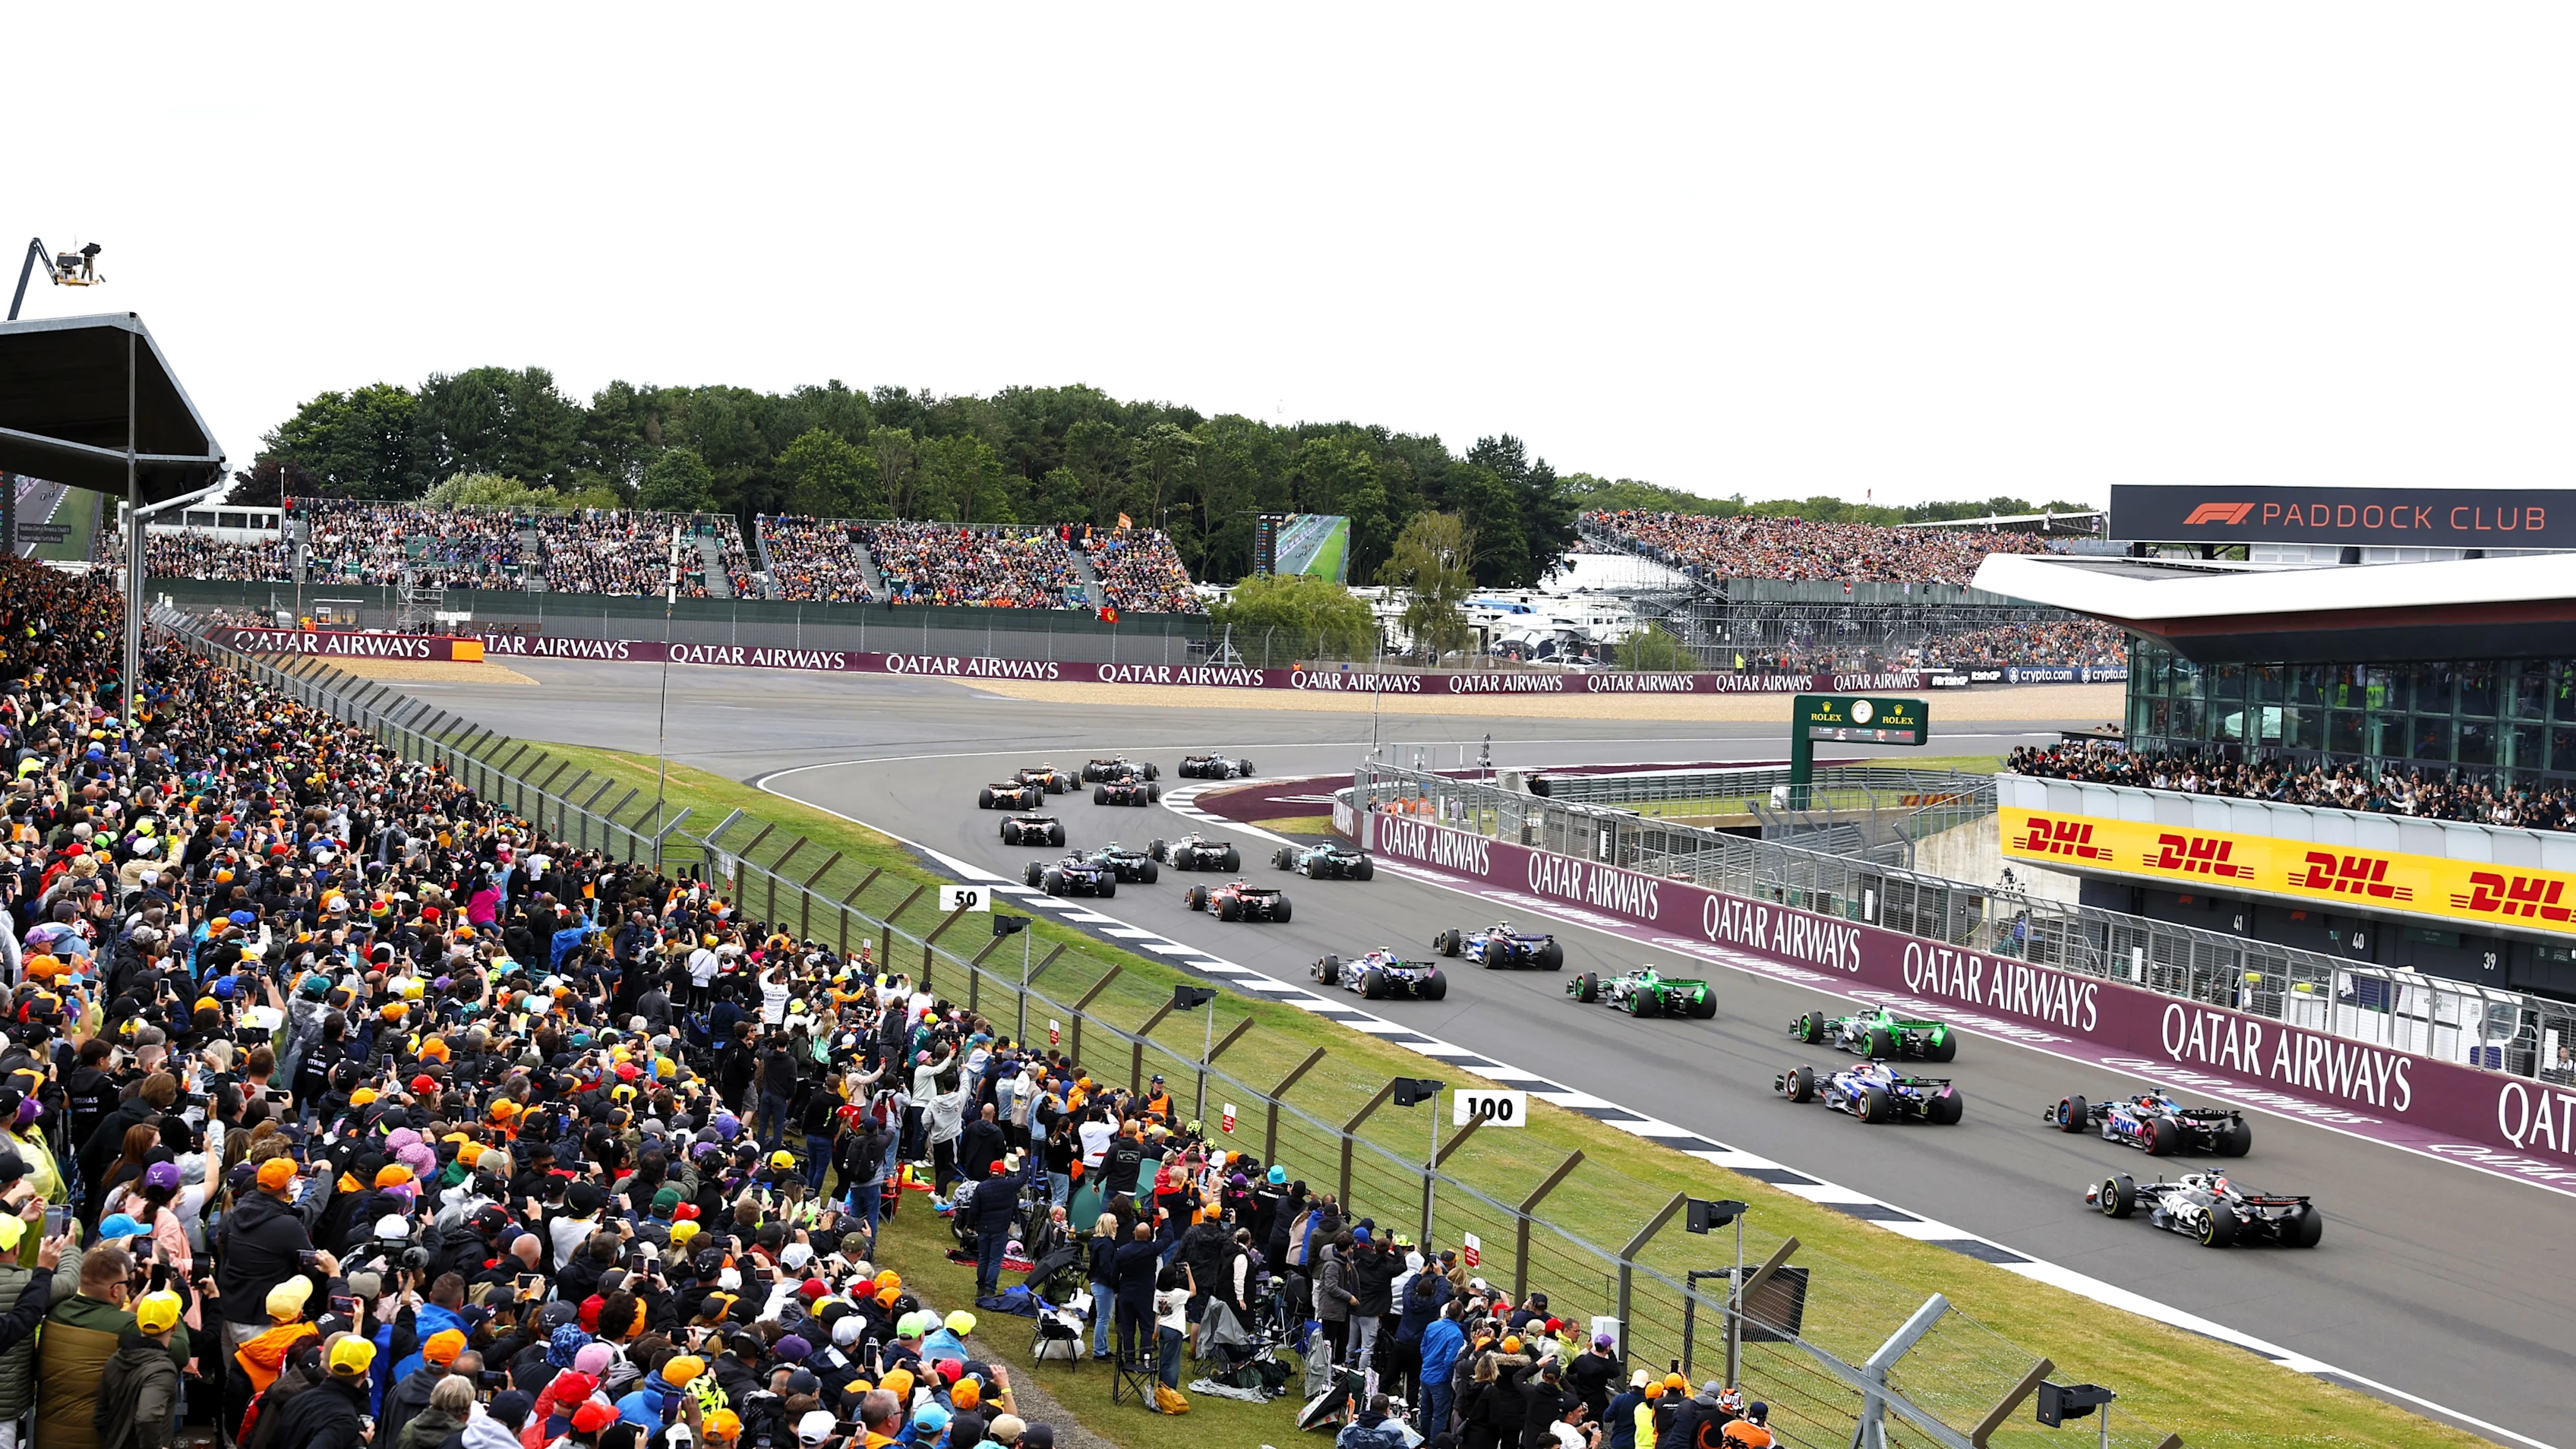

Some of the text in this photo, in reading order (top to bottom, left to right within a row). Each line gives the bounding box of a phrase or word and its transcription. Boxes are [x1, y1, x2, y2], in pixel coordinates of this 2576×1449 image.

[2262, 503, 2432, 529] PADDOCK
[2450, 507, 2546, 530] CLUB
[235, 631, 431, 658] QATAR AIRWAYS
[533, 638, 630, 659] AIRWAYS
[671, 644, 846, 670] QATAR AIRWAYS
[886, 655, 1059, 680] QATAR AIRWAYS
[1099, 664, 1265, 687] QATAR AIRWAYS
[1291, 671, 1421, 692] QATAR AIRWAYS
[1450, 674, 1563, 694] QATAR AIRWAYS
[1587, 674, 1694, 693] QATAR AIRWAYS
[1716, 674, 1813, 692] QATAR AIRWAYS
[1833, 673, 1920, 692] QATAR AIRWAYS
[2021, 668, 2072, 682] crypto.com
[2093, 668, 2128, 681] crypto.co
[1810, 713, 1842, 721] ROLEX
[1882, 716, 1914, 724] ROLEX
[1381, 816, 1426, 860] QATAR
[1429, 829, 1489, 876] AIRWAYS
[2026, 817, 2098, 859] DHL
[2158, 833, 2239, 877] DHL
[1528, 852, 1581, 901] QATAR
[1586, 866, 1659, 920] AIRWAYS
[2304, 851, 2395, 898] DHL
[955, 891, 977, 907] 50
[2469, 871, 2571, 922] DHL
[2233, 914, 2243, 931] 41
[1703, 895, 1860, 974] QATAR AIRWAYS
[2352, 933, 2364, 949] 40
[2483, 952, 2496, 970] 39
[1903, 942, 2098, 1033] QATAR AIRWAYS
[2161, 1002, 2412, 1113] QATAR AIRWAYS
[1468, 1097, 1513, 1121] 100
[2499, 1082, 2576, 1154] QAT
[2114, 1116, 2138, 1135] BWT
